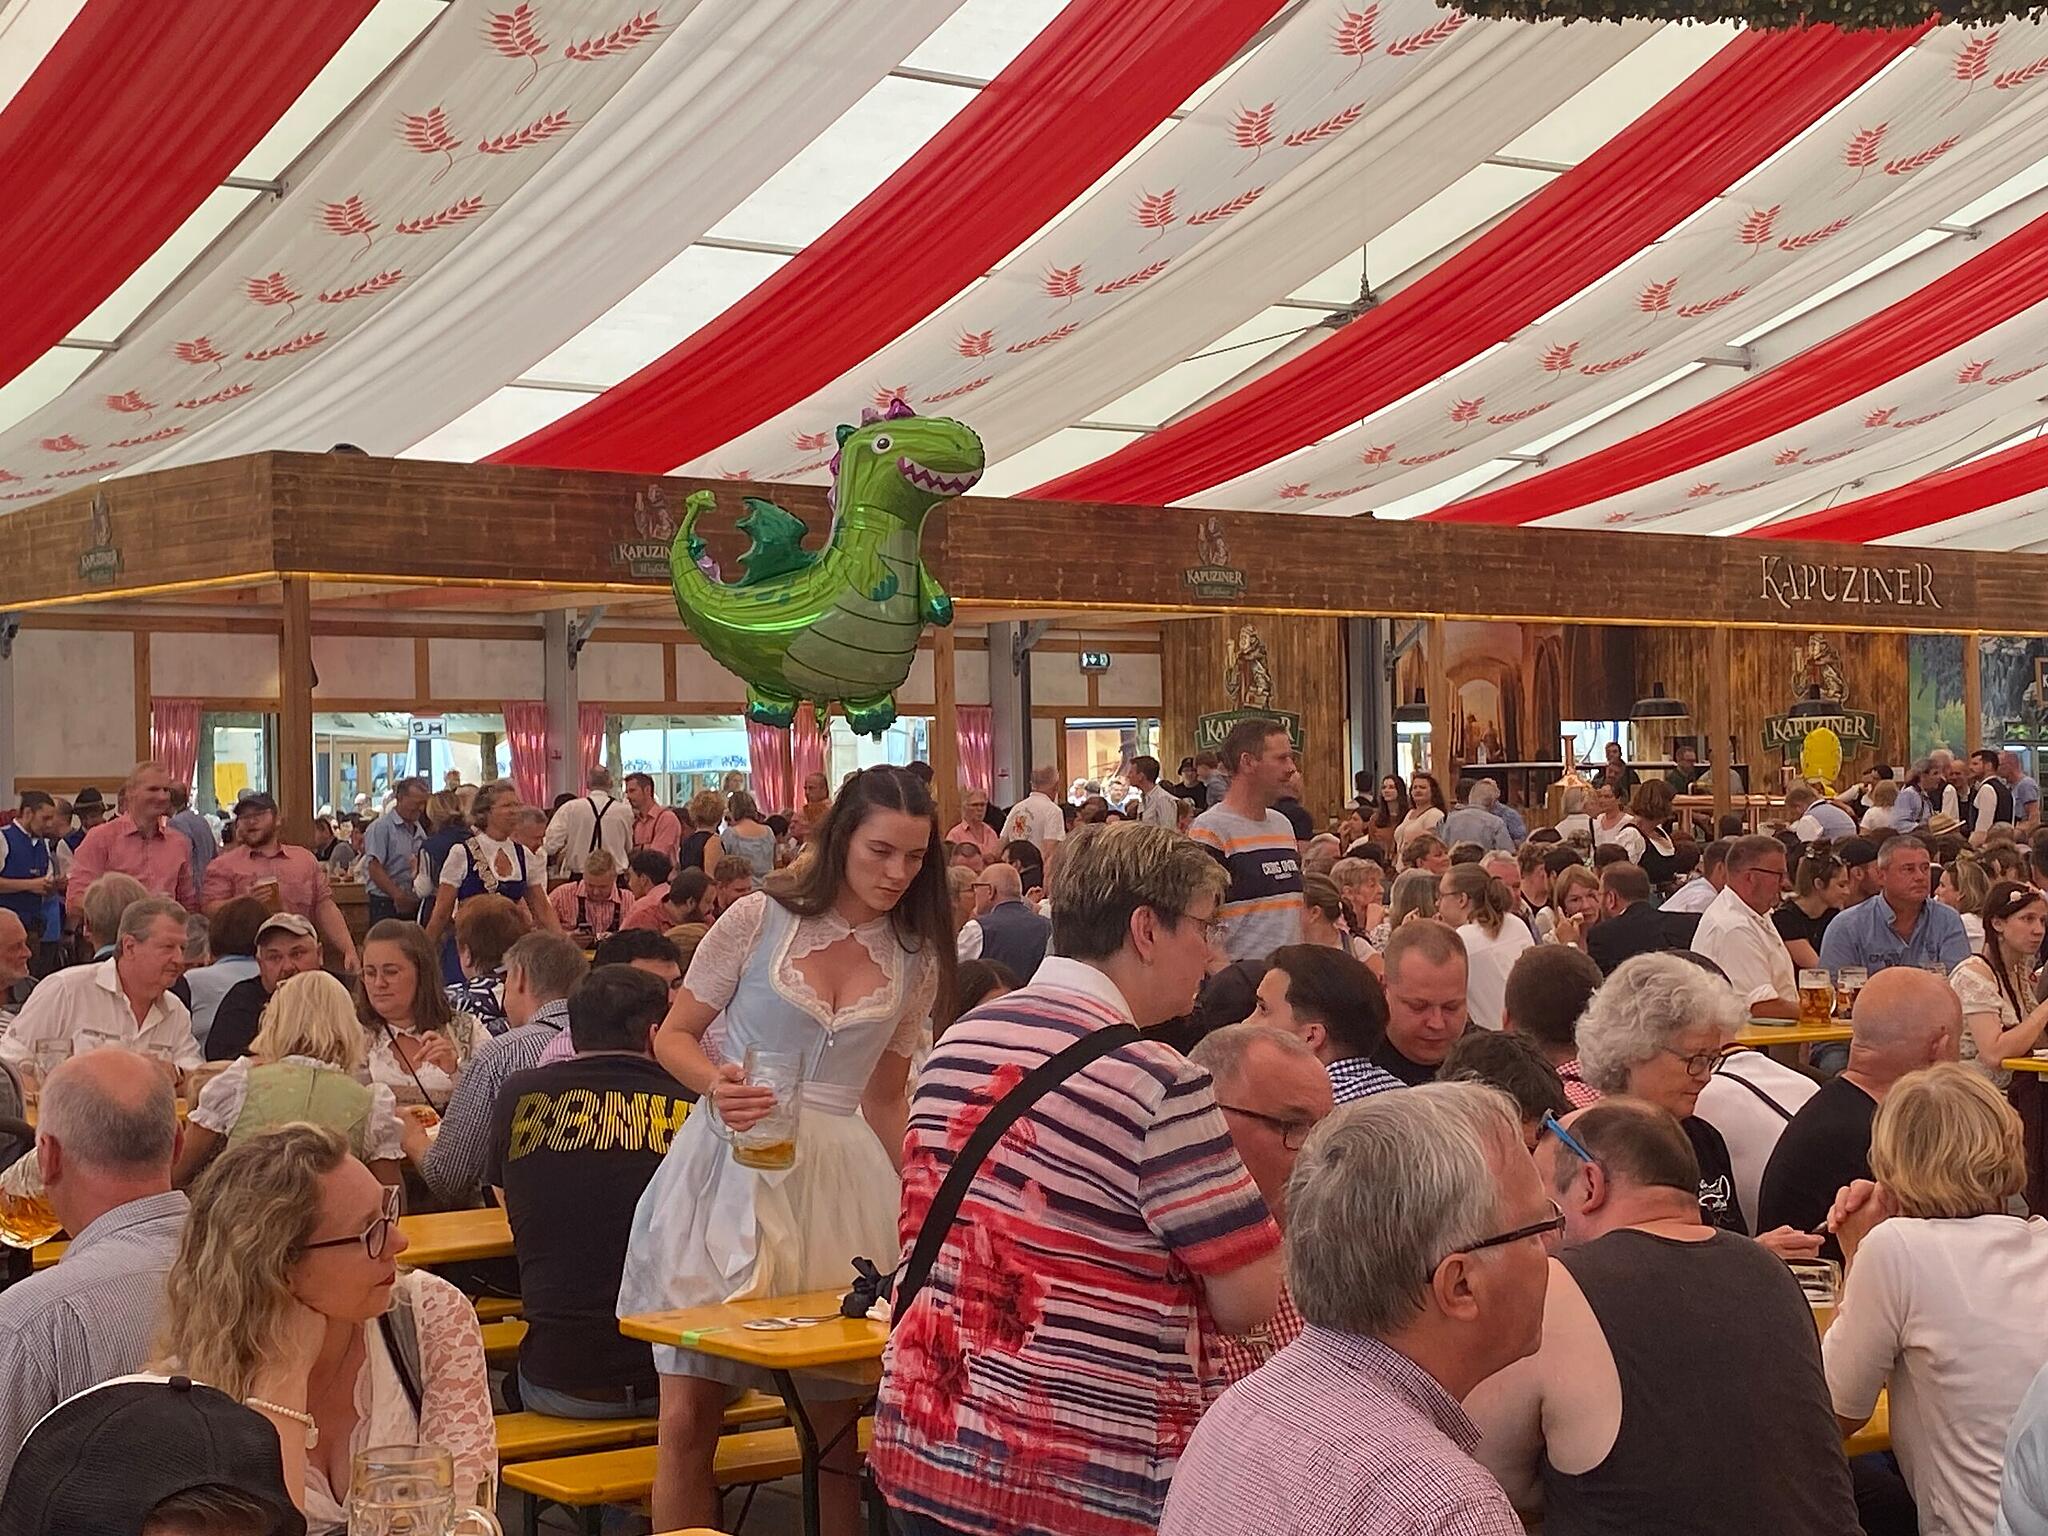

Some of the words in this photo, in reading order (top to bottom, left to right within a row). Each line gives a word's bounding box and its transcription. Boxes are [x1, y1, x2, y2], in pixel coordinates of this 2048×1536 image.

[619, 543, 672, 561] KAPUZIN
[1186, 568, 1244, 586] KAPUZINER
[1760, 555, 1943, 609] KAPUZINER
[1771, 715, 1871, 742] KAPUZINER
